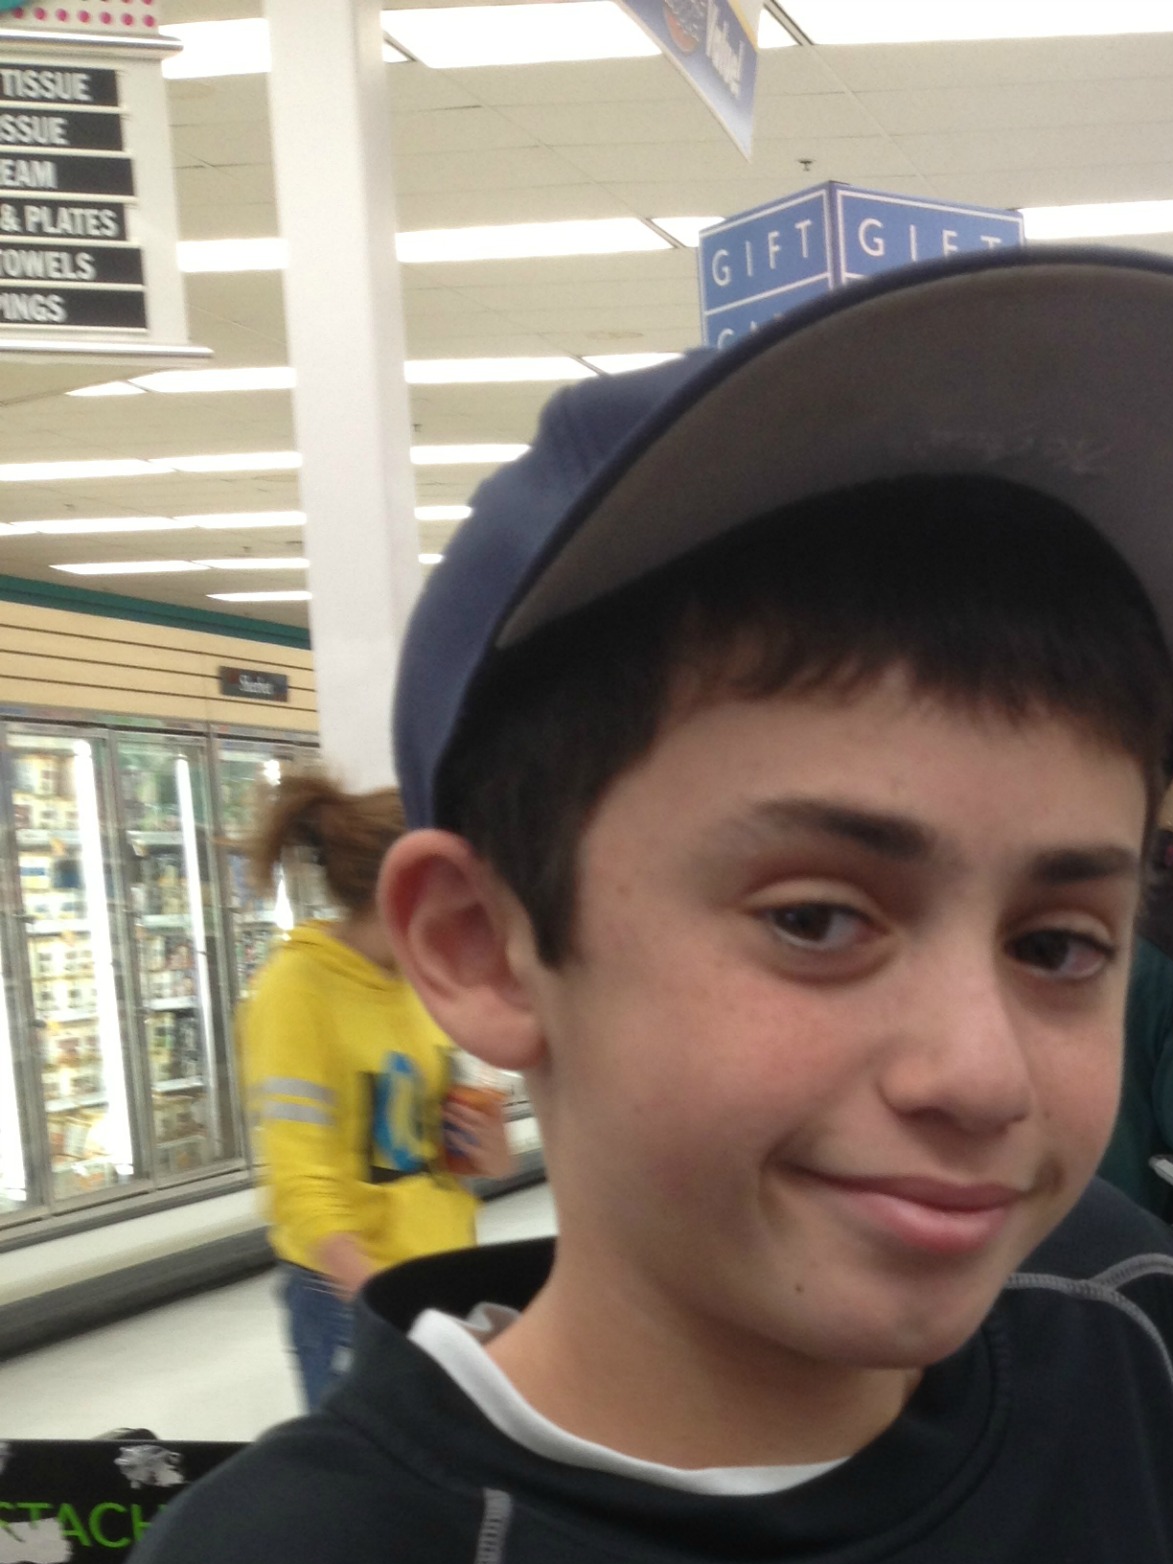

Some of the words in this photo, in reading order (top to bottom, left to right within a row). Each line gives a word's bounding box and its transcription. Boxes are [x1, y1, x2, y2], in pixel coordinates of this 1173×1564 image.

[2, 69, 93, 101] TISSUE
[25, 204, 120, 238] PLATES
[711, 219, 813, 288] GIFT
